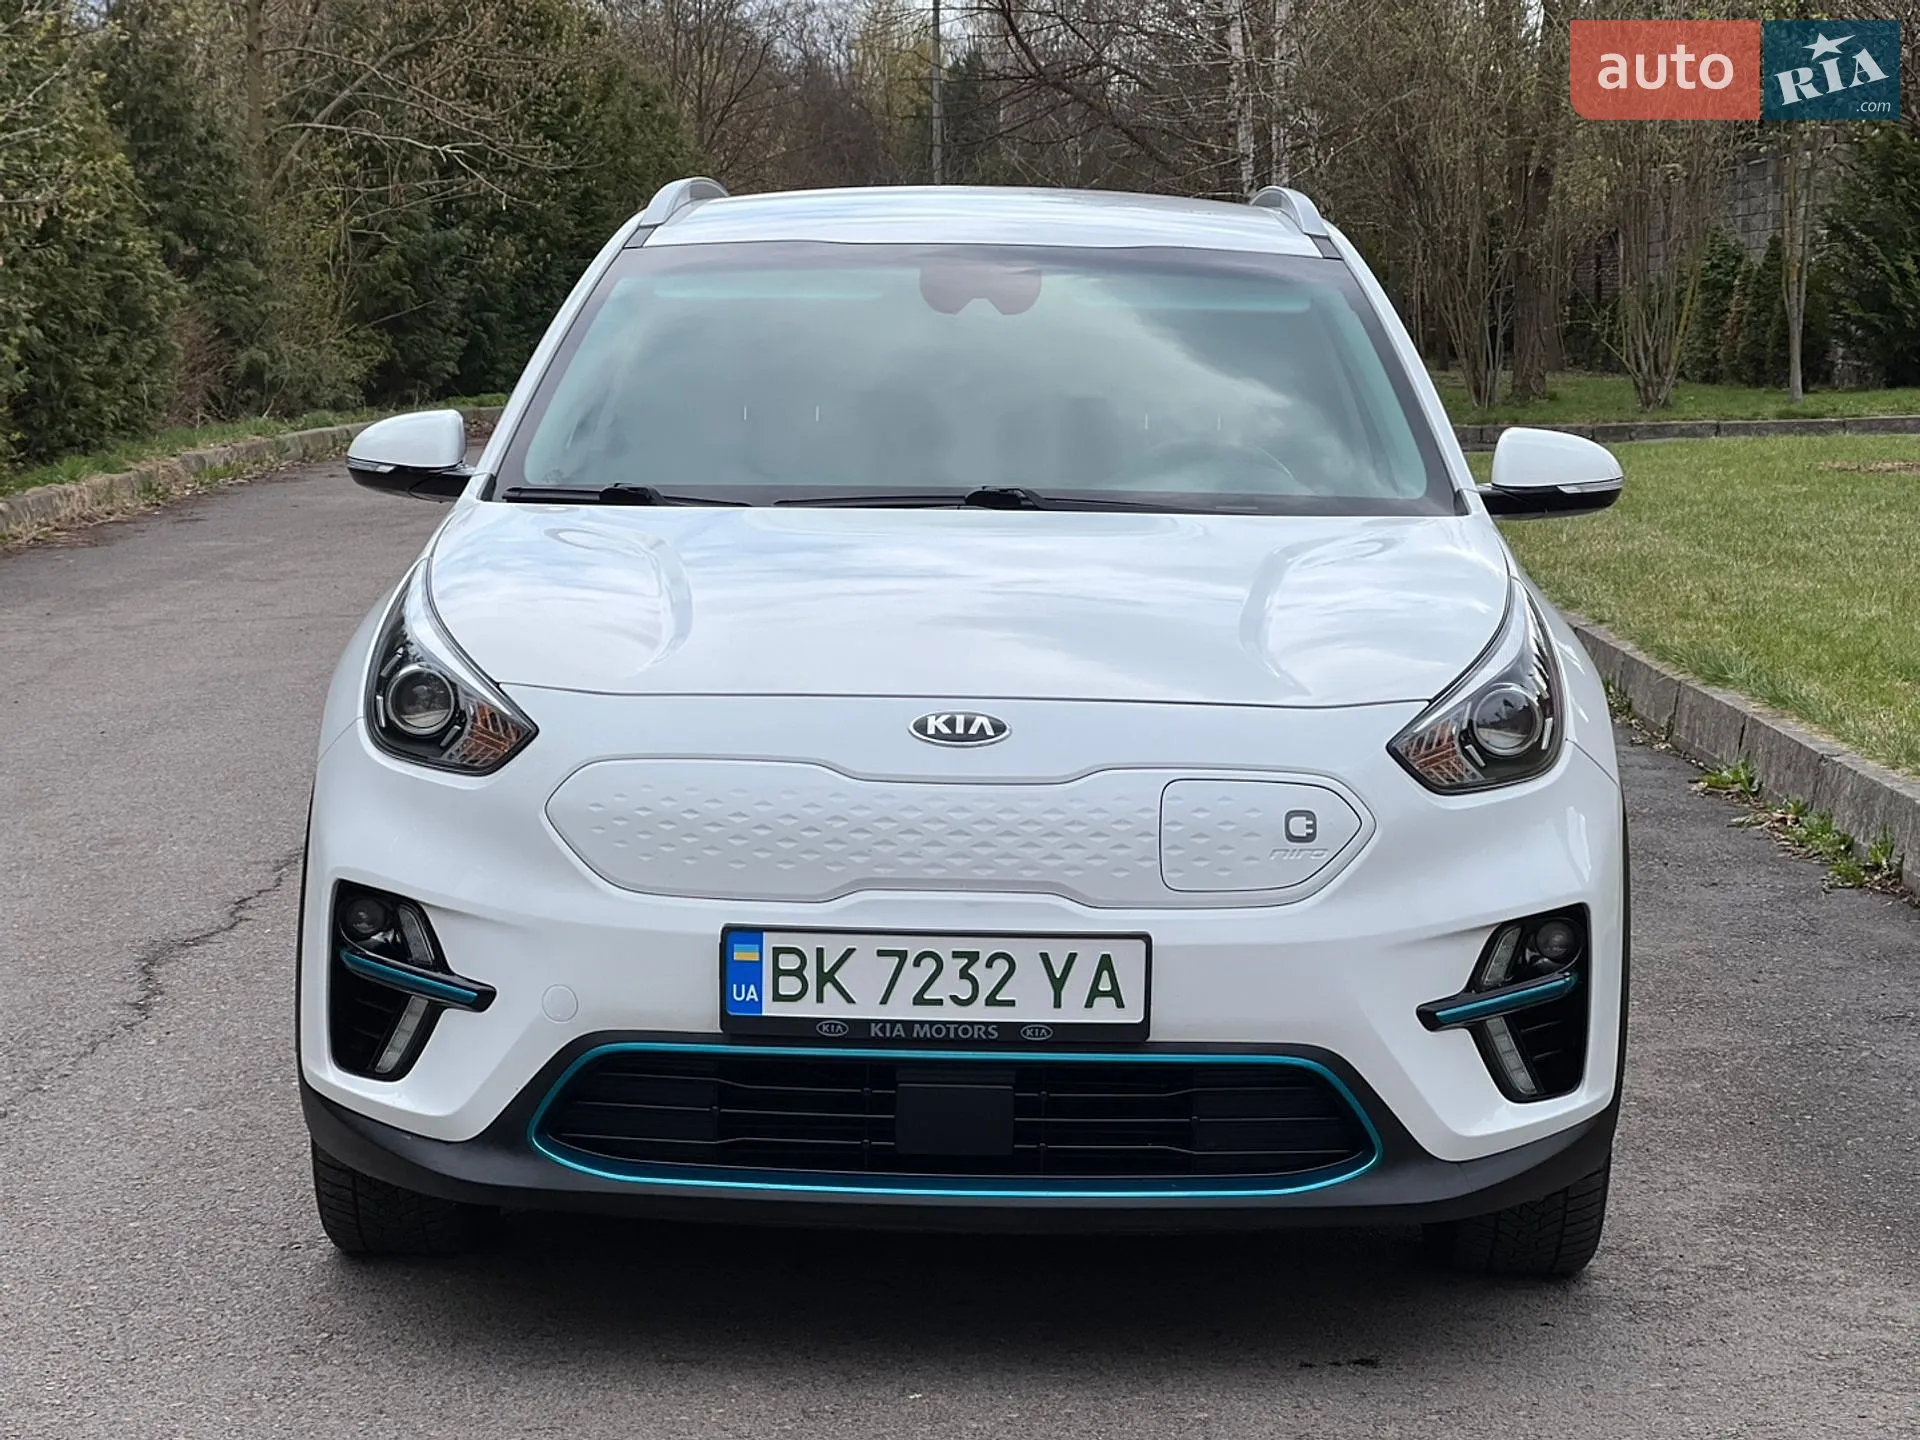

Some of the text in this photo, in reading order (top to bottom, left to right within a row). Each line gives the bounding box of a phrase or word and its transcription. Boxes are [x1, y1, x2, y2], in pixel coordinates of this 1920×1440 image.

[926, 714, 995, 736] KIA
[772, 946, 1125, 1009] BK 7232 YA
[733, 984, 759, 1002] UA
[822, 1024, 844, 1033] KIA
[869, 1022, 999, 1039] KIA MOTORS
[1025, 1027, 1048, 1037] KIA
